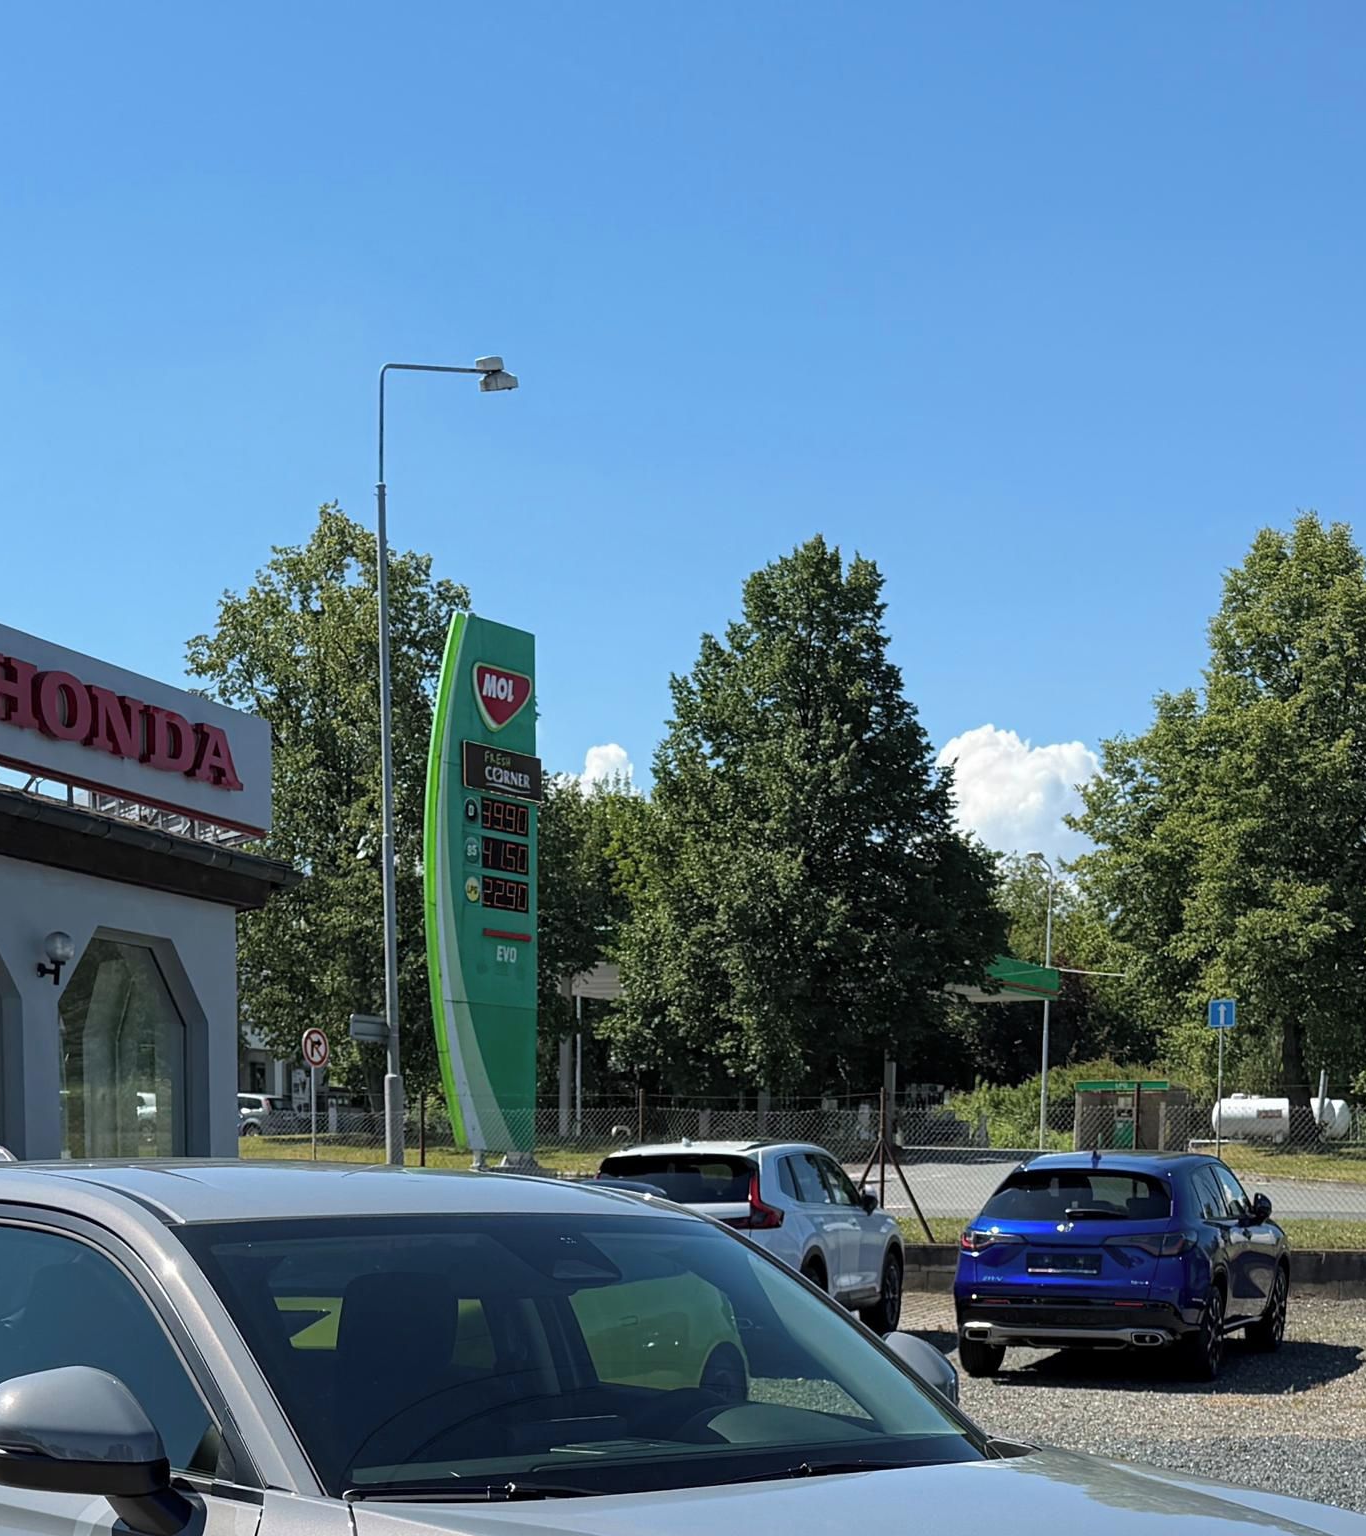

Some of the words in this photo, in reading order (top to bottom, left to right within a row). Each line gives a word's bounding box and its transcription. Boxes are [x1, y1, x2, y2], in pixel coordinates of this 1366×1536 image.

[482, 673, 515, 702] MOL
[484, 765, 531, 789] CORNER
[496, 944, 517, 963] EVO
